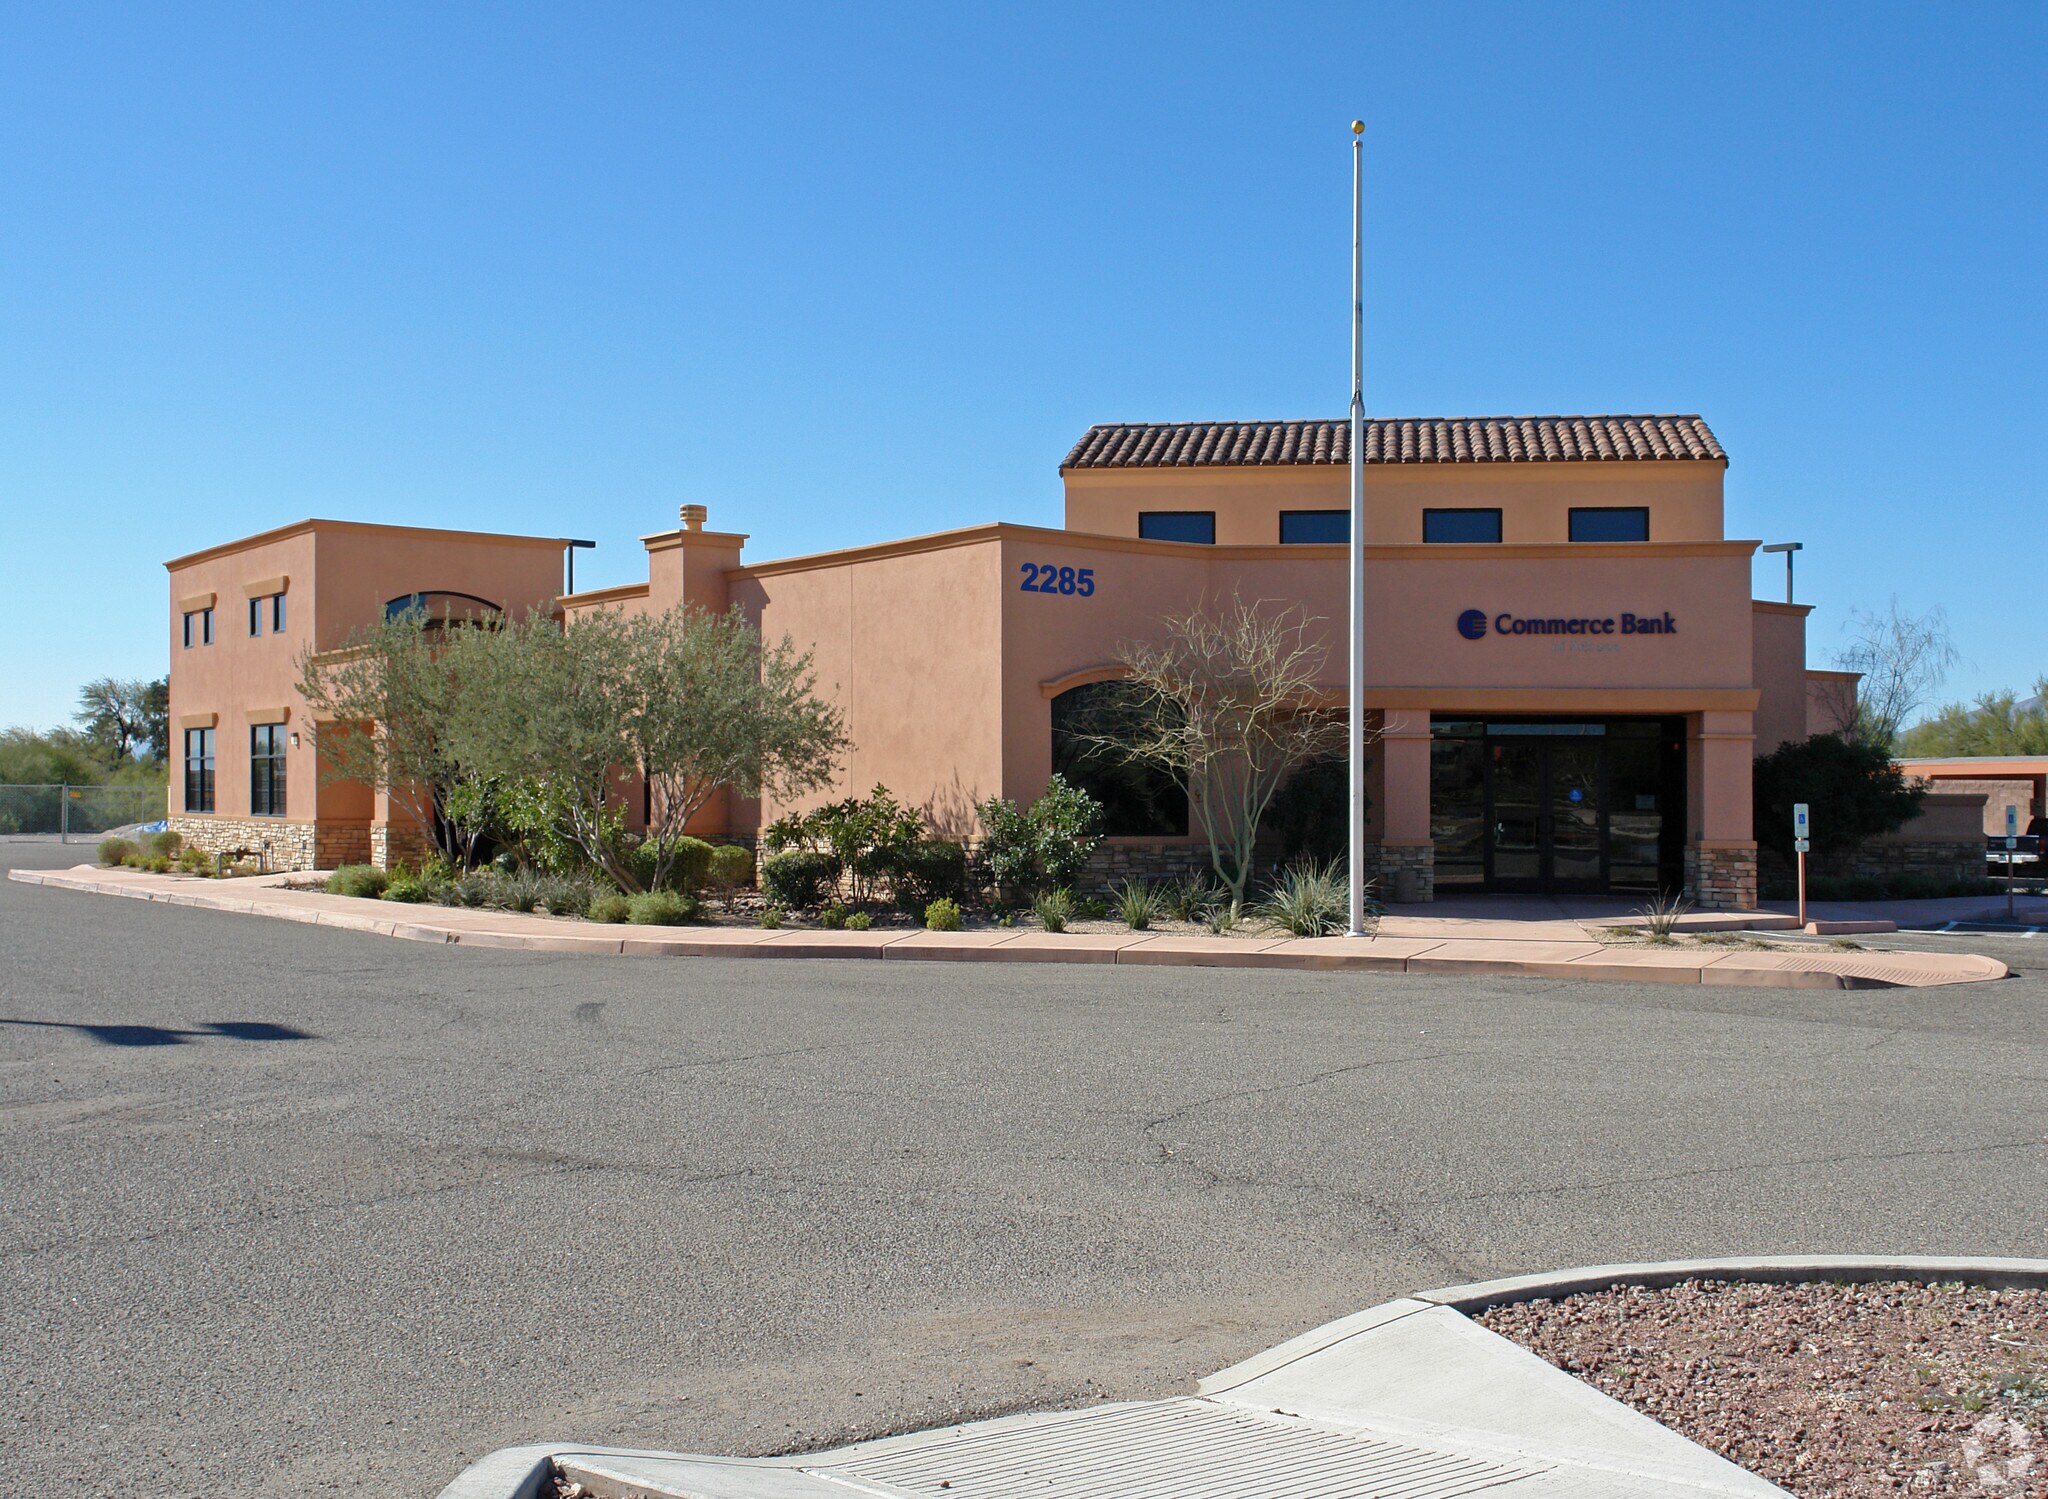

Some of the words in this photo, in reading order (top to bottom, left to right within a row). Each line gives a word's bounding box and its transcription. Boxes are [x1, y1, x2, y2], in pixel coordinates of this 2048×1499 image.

[1020, 562, 1095, 597] 2285
[1495, 613, 1615, 635] Commerce
[1620, 611, 1677, 635] Bank
